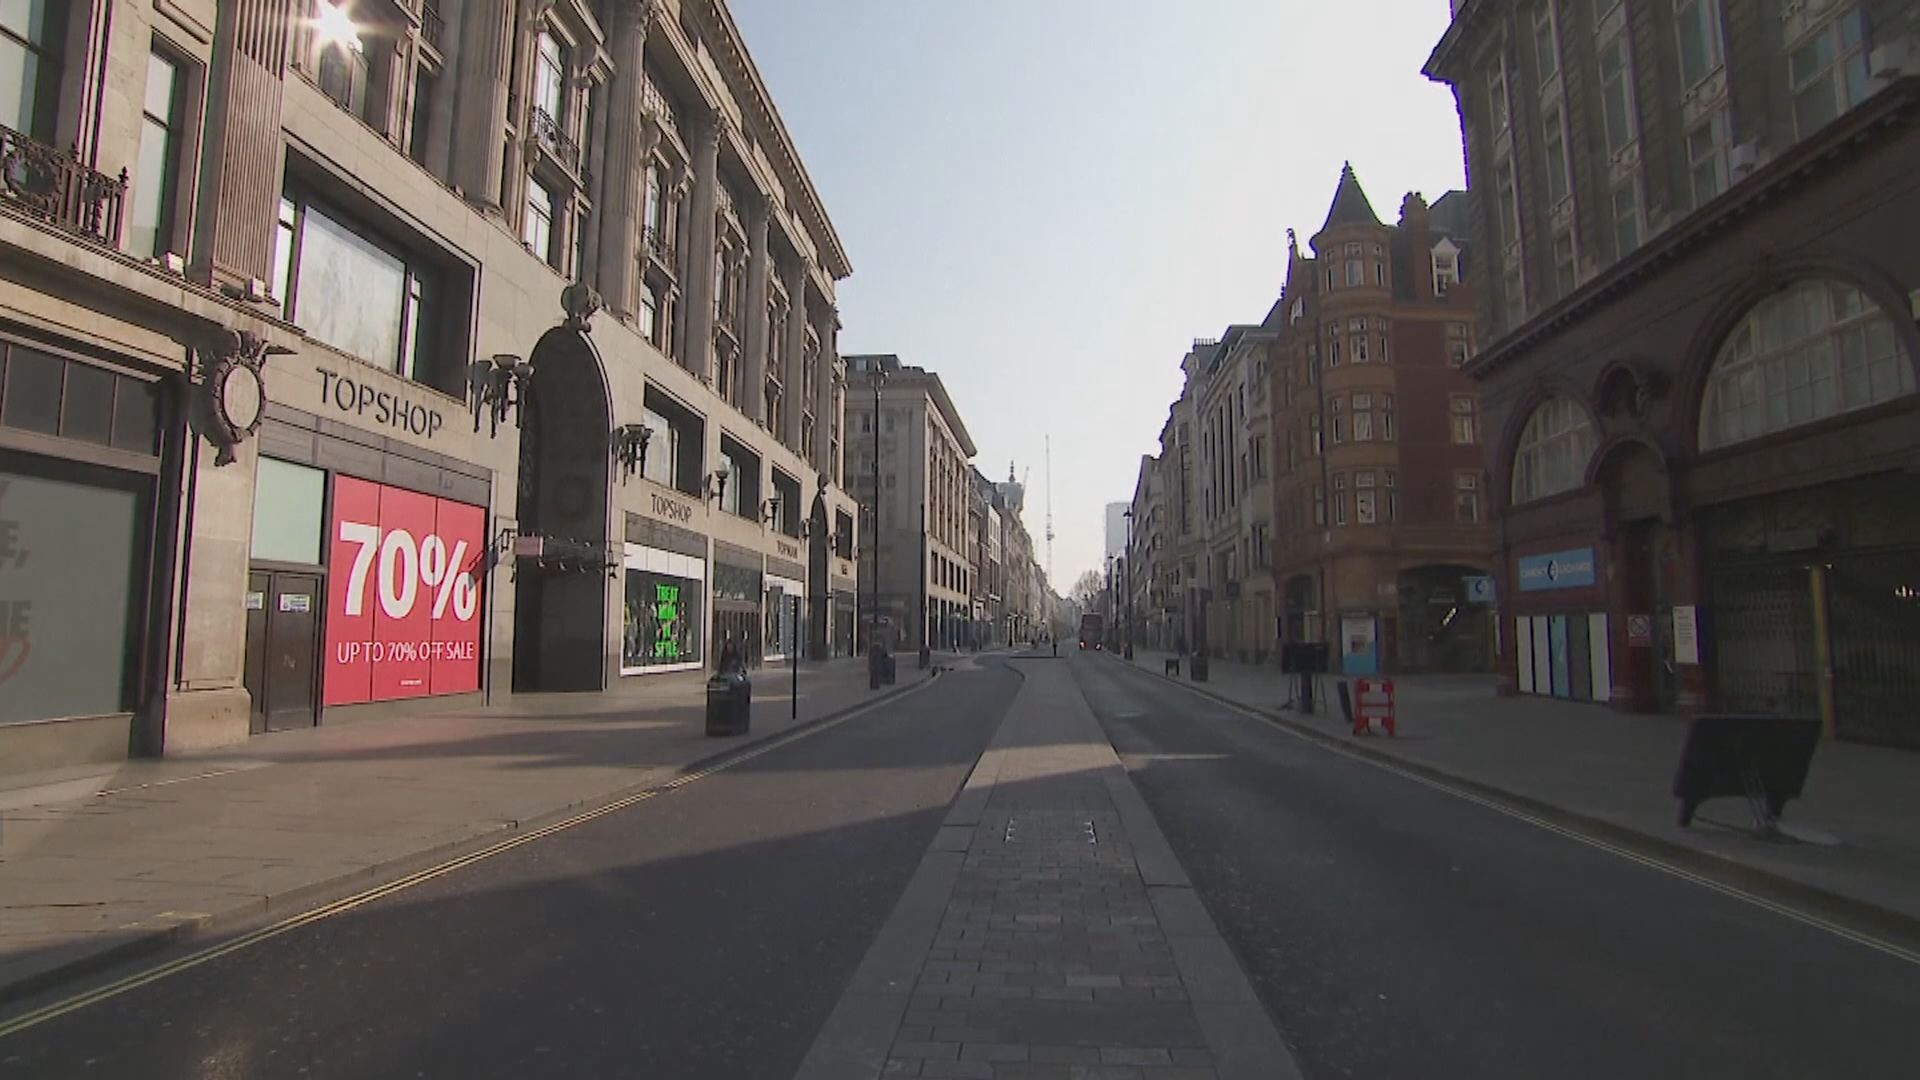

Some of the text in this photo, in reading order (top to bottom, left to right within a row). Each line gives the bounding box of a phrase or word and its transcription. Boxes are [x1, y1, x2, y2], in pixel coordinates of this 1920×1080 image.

[316, 366, 442, 439] TOPSHOP
[651, 493, 692, 523] TOPSHOP
[340, 520, 477, 621] 70%
[656, 584, 679, 601] TREAT
[337, 640, 474, 664] UP TO 70% OFF SALE
